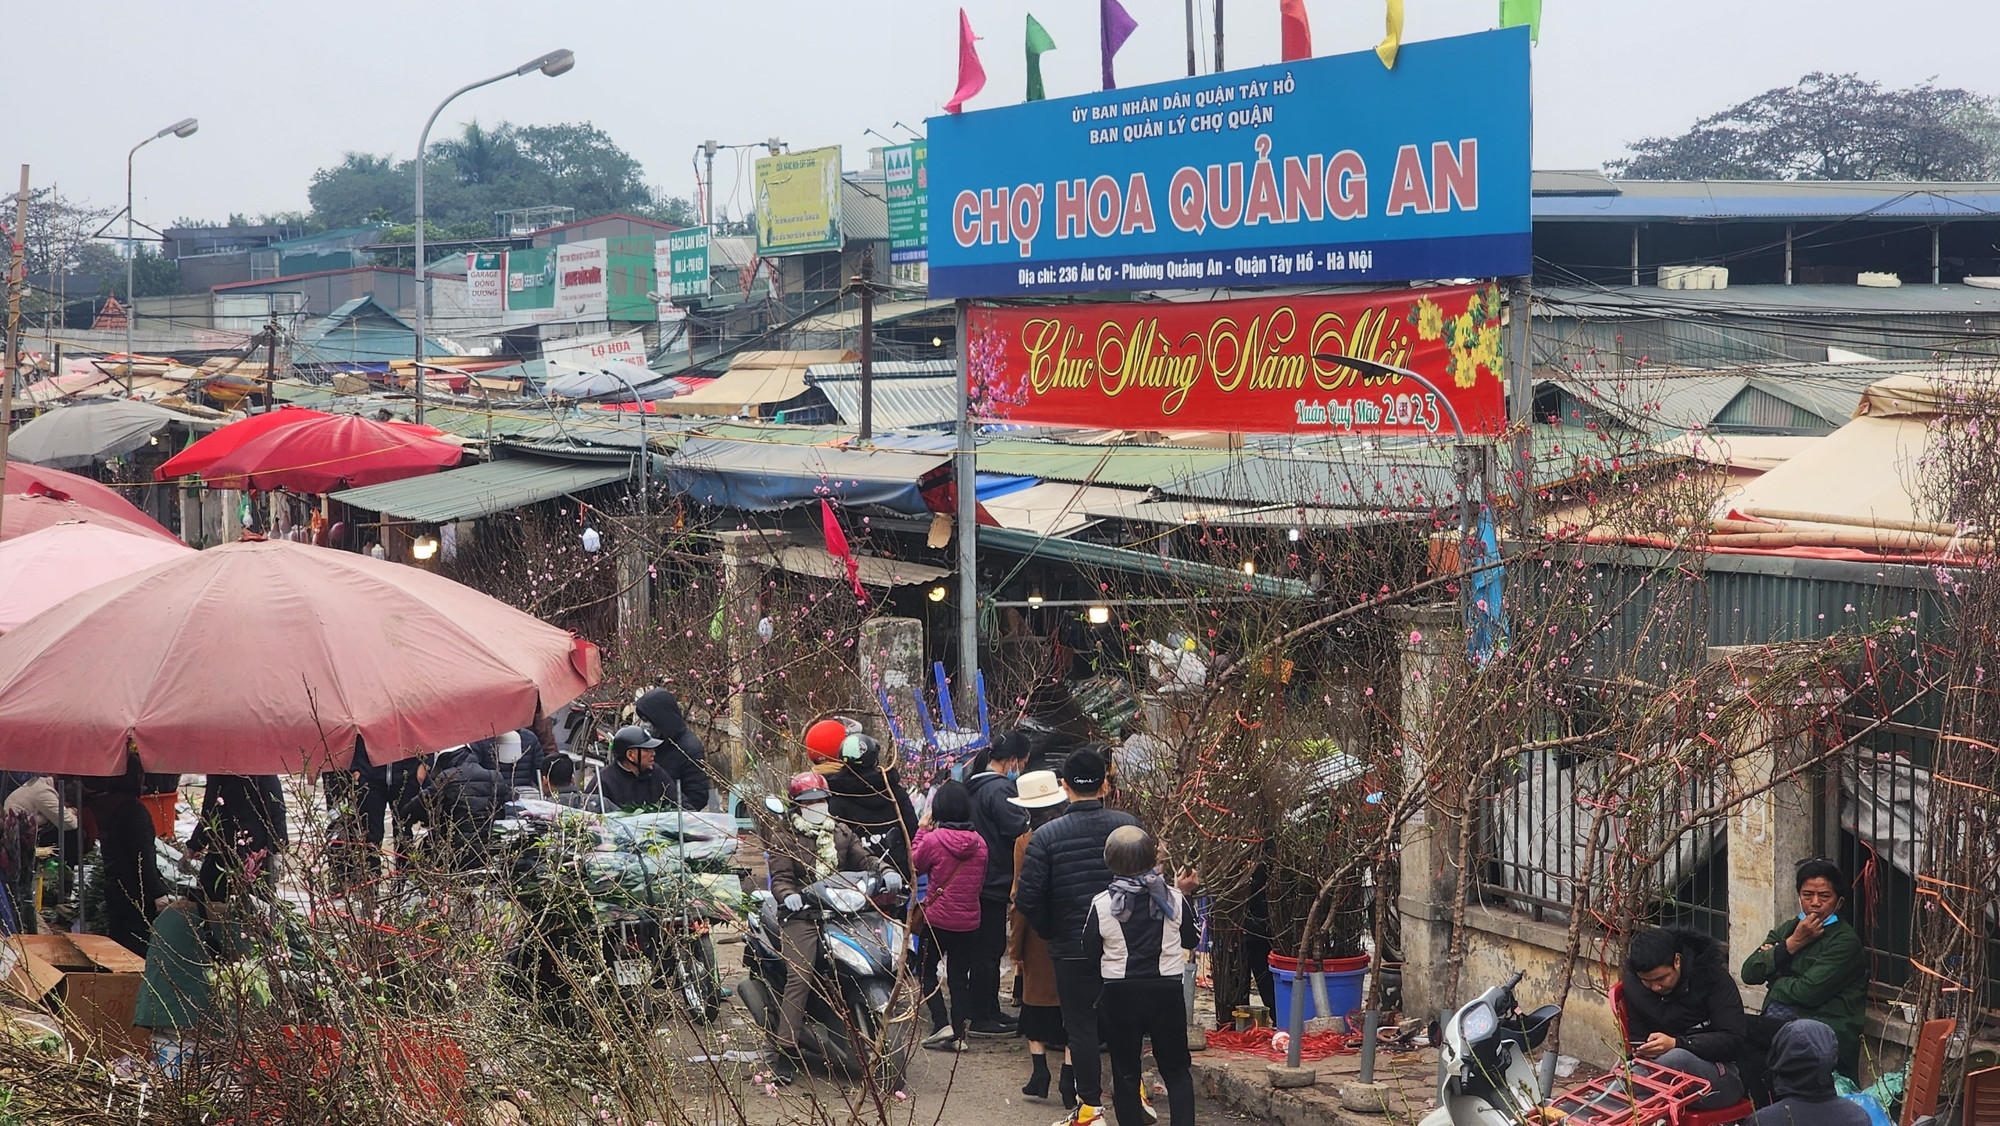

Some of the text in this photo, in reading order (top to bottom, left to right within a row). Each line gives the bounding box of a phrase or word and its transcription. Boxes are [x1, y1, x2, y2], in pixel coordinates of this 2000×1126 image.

[1072, 71, 1295, 123] ỦY BAN NHÂN DÂN QUẬN TÂY HỒ
[1090, 104, 1273, 144] BAN QUẢN LÝ CHỢ QUẬN
[952, 182, 1045, 258] CHỢ
[1056, 172, 1156, 240] HOA
[1168, 133, 1368, 236] QUẢNG
[1386, 137, 1478, 216] AN
[685, 235, 695, 249] LAN
[695, 230, 707, 248] VIÊN
[1018, 268, 1035, 288] Địa
[1037, 265, 1057, 284] chỉ:
[1058, 266, 1078, 283] 236
[1080, 262, 1095, 282] Âu
[1097, 264, 1112, 281] Cơ
[1121, 261, 1164, 280] Phường
[1166, 258, 1204, 279] Quảng
[1206, 258, 1223, 276] An
[1234, 255, 1267, 277] Quận
[1270, 254, 1293, 275] Tây
[1296, 250, 1314, 272] Hồ
[1326, 251, 1345, 270] Hà
[1348, 250, 1373, 273] Nội
[591, 344, 605, 358] LỌ
[608, 341, 630, 354] HOA
[1021, 305, 1414, 415] Chúc Mừng Năm Mới
[1295, 393, 1440, 431] Xuân Quý Mão 2023
